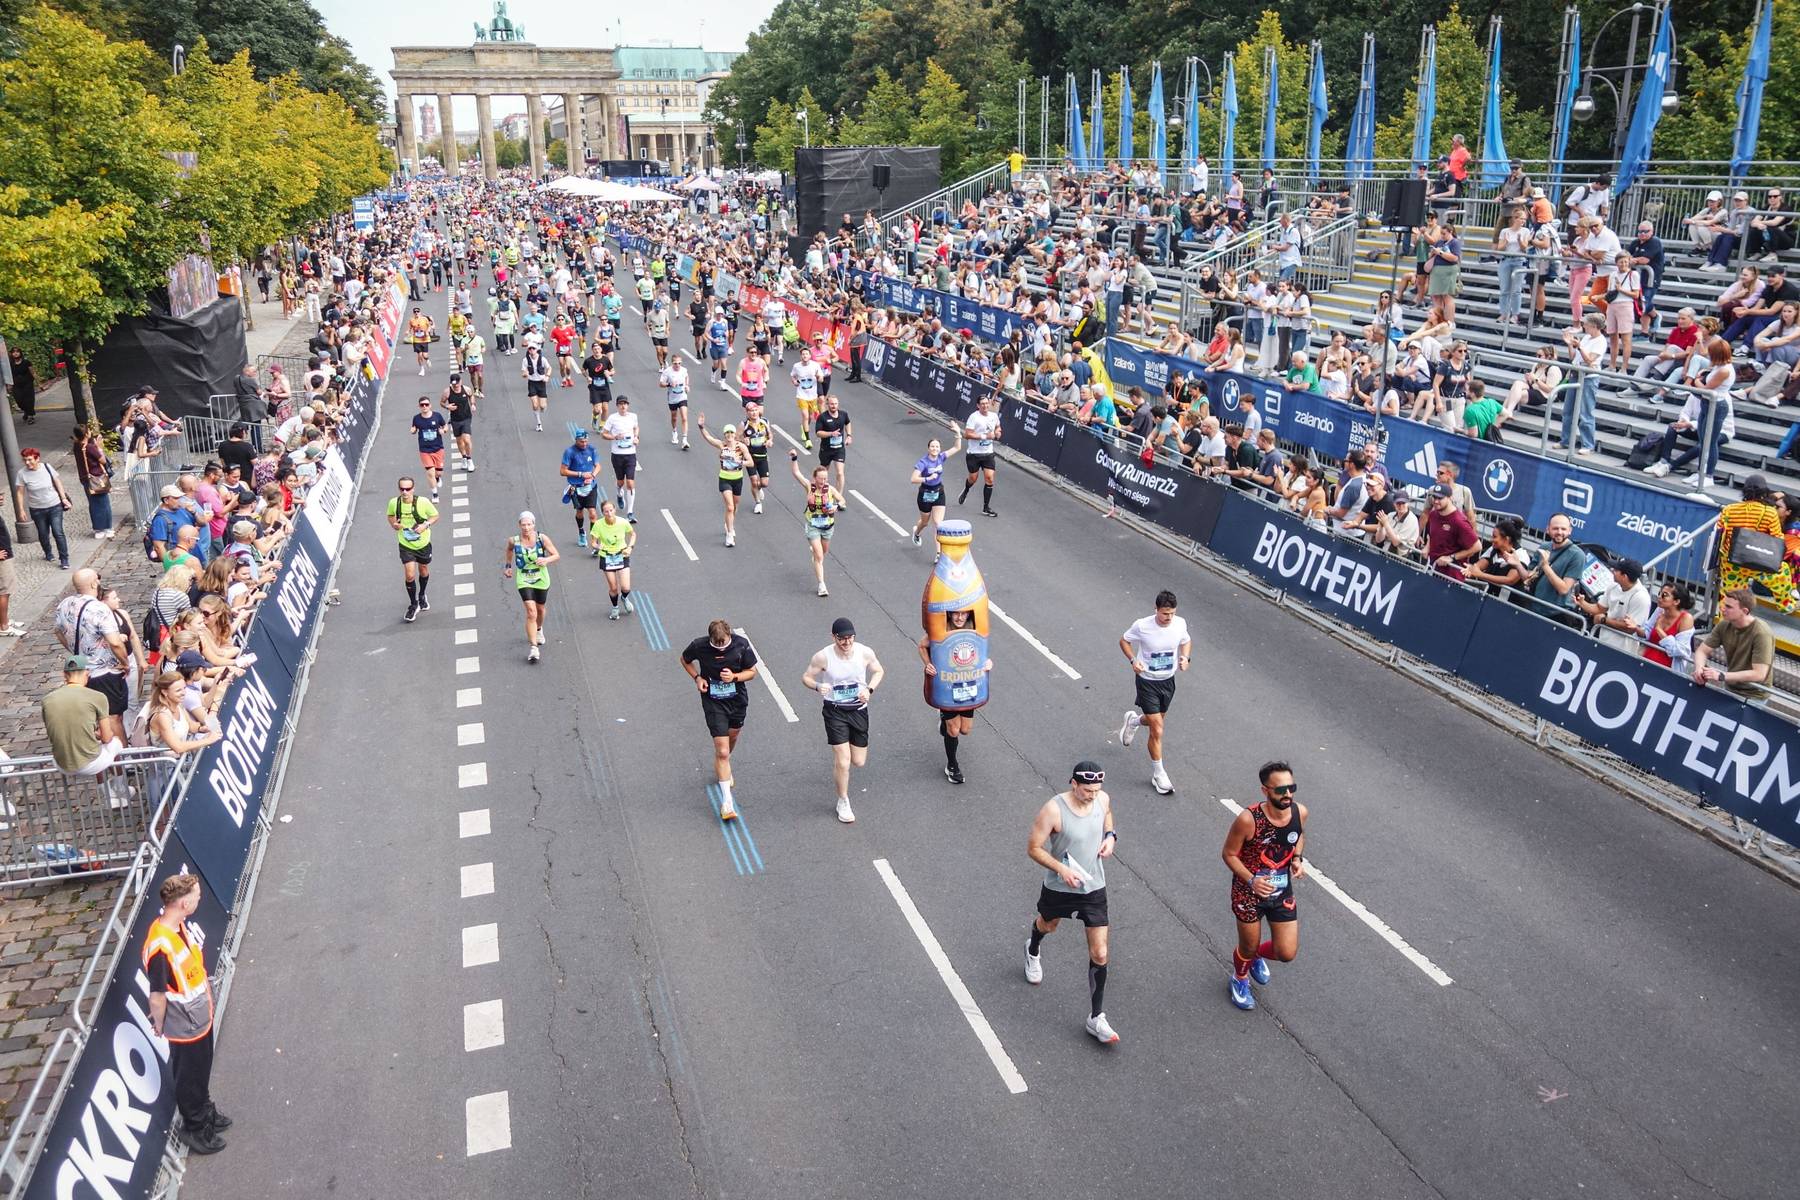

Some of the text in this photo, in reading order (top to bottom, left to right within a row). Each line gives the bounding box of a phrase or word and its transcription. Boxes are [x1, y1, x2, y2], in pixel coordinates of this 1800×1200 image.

[1294, 410, 1334, 434] zalando
[1123, 488, 1131, 498] on
[1131, 491, 1150, 507] sleep
[1617, 512, 1693, 548] zalando
[276, 542, 320, 638] BIOTHERM
[1253, 521, 1403, 626] BIOTHERM
[941, 670, 985, 683] ERDINGE
[209, 666, 278, 829] BIOTHERM
[1539, 647, 1800, 824] BIOTHERM
